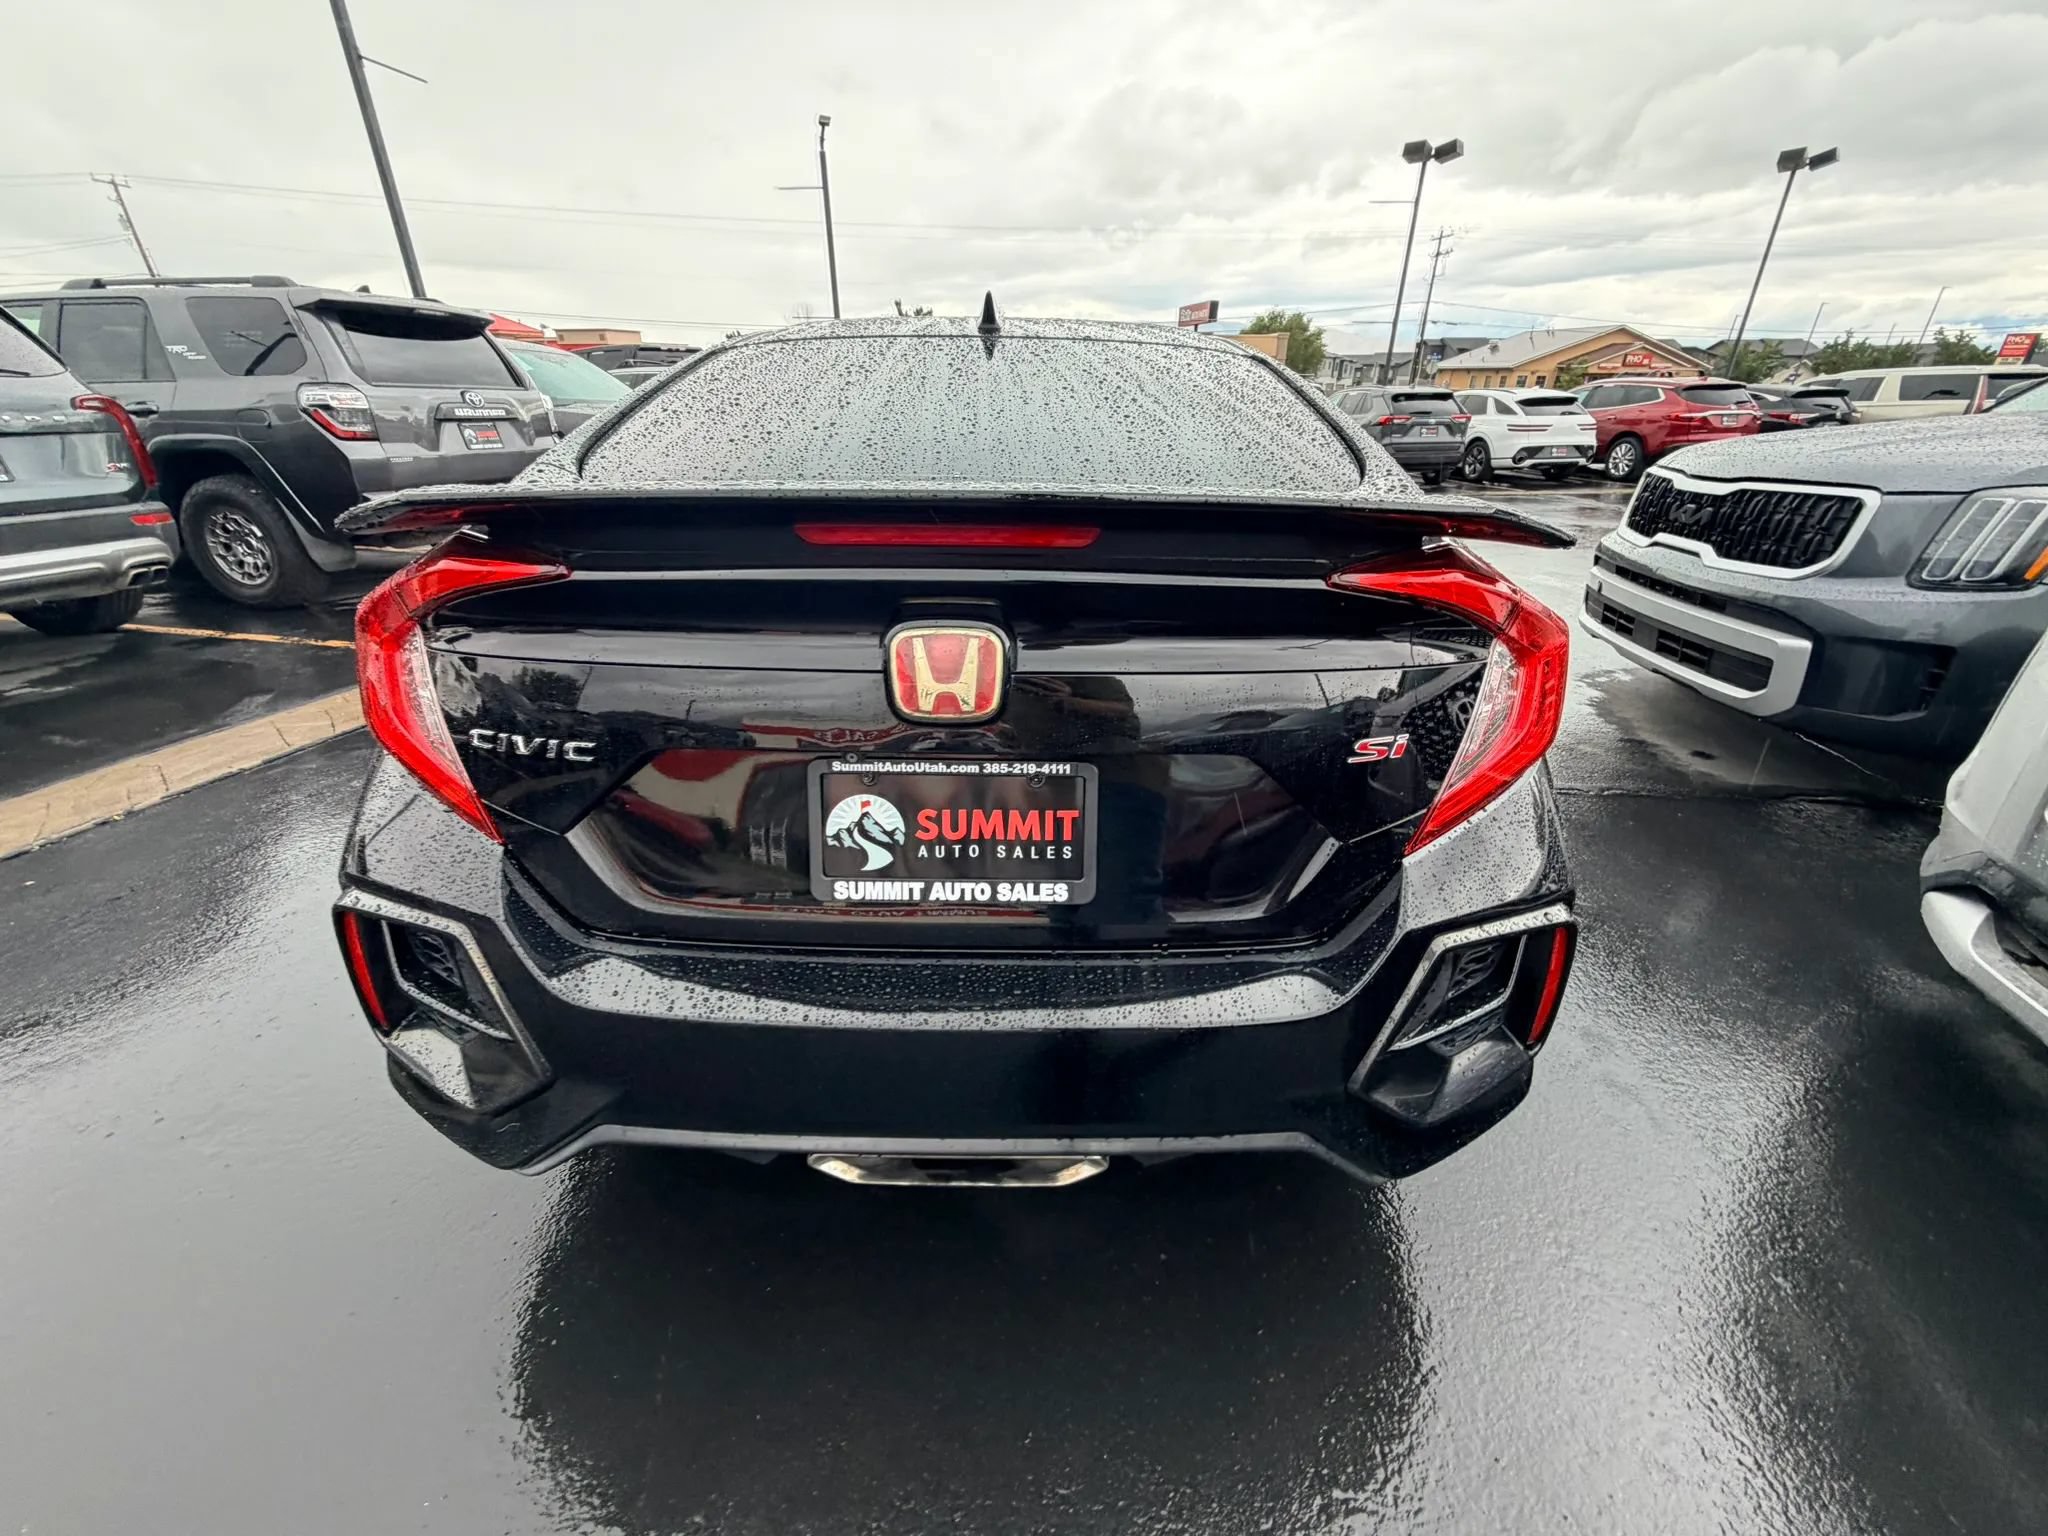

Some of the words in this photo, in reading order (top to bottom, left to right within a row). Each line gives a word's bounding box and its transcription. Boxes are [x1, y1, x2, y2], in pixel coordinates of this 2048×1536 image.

[469, 728, 598, 762] CIVIC
[1347, 733, 1410, 763] Si
[831, 761, 980, 773] SummitAutoUtah.com
[983, 763, 1071, 775] 385-219-4111
[914, 808, 1080, 841] SUMMIT
[917, 844, 980, 858] AUTO
[996, 845, 1073, 859] SALES
[833, 880, 925, 900] SUMMIT
[929, 882, 992, 901] AUTO
[996, 883, 1069, 902] SALES
